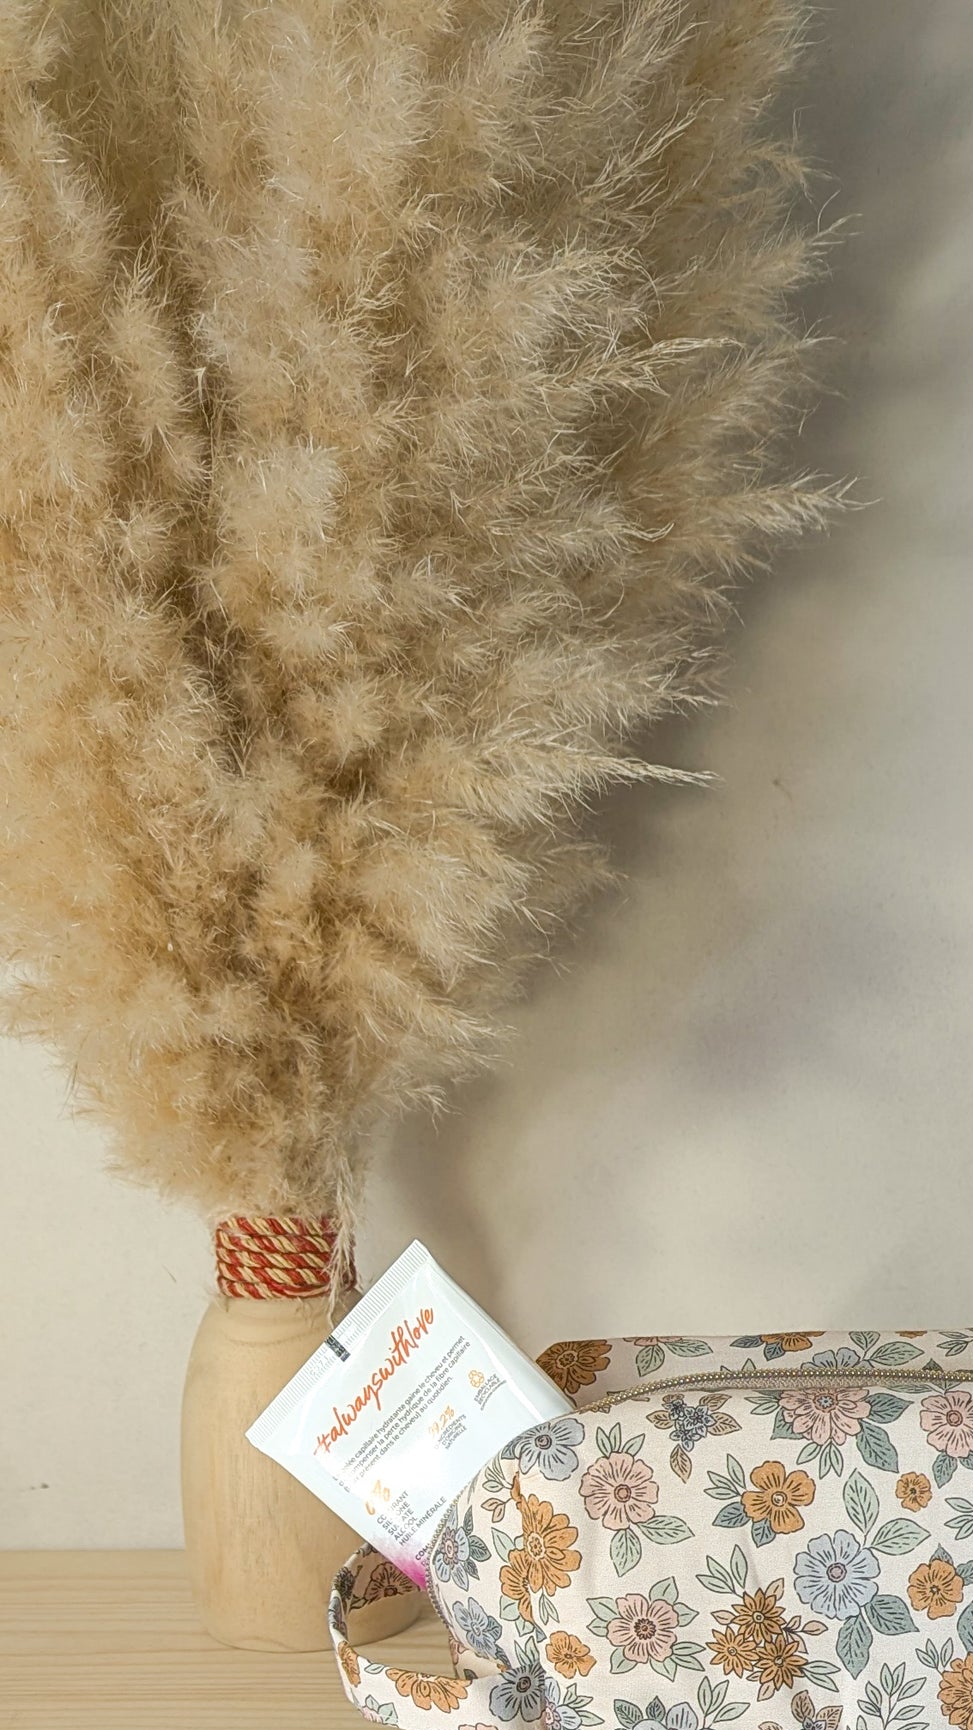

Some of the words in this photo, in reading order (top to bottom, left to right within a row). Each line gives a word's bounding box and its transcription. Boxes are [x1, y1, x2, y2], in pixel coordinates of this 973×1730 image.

[314, 1308, 434, 1456] #alwayswithlove
[355, 1432, 378, 1459] capillaire
[377, 1403, 406, 1435] hydratante
[405, 1388, 421, 1406] gaine
[418, 1382, 425, 1390] le
[425, 1363, 443, 1384] cheveu
[447, 1336, 465, 1358] permet
[377, 1437, 385, 1445] la
[384, 1422, 400, 1440] perte
[398, 1396, 424, 1426] hydrique
[423, 1388, 433, 1397] de
[431, 1381, 438, 1389] la
[436, 1368, 449, 1382] fibre
[448, 1341, 471, 1368] capillaire
[380, 1439, 395, 1456] dans
[419, 1404, 428, 1414] au
[426, 1376, 453, 1406] quotidien.
